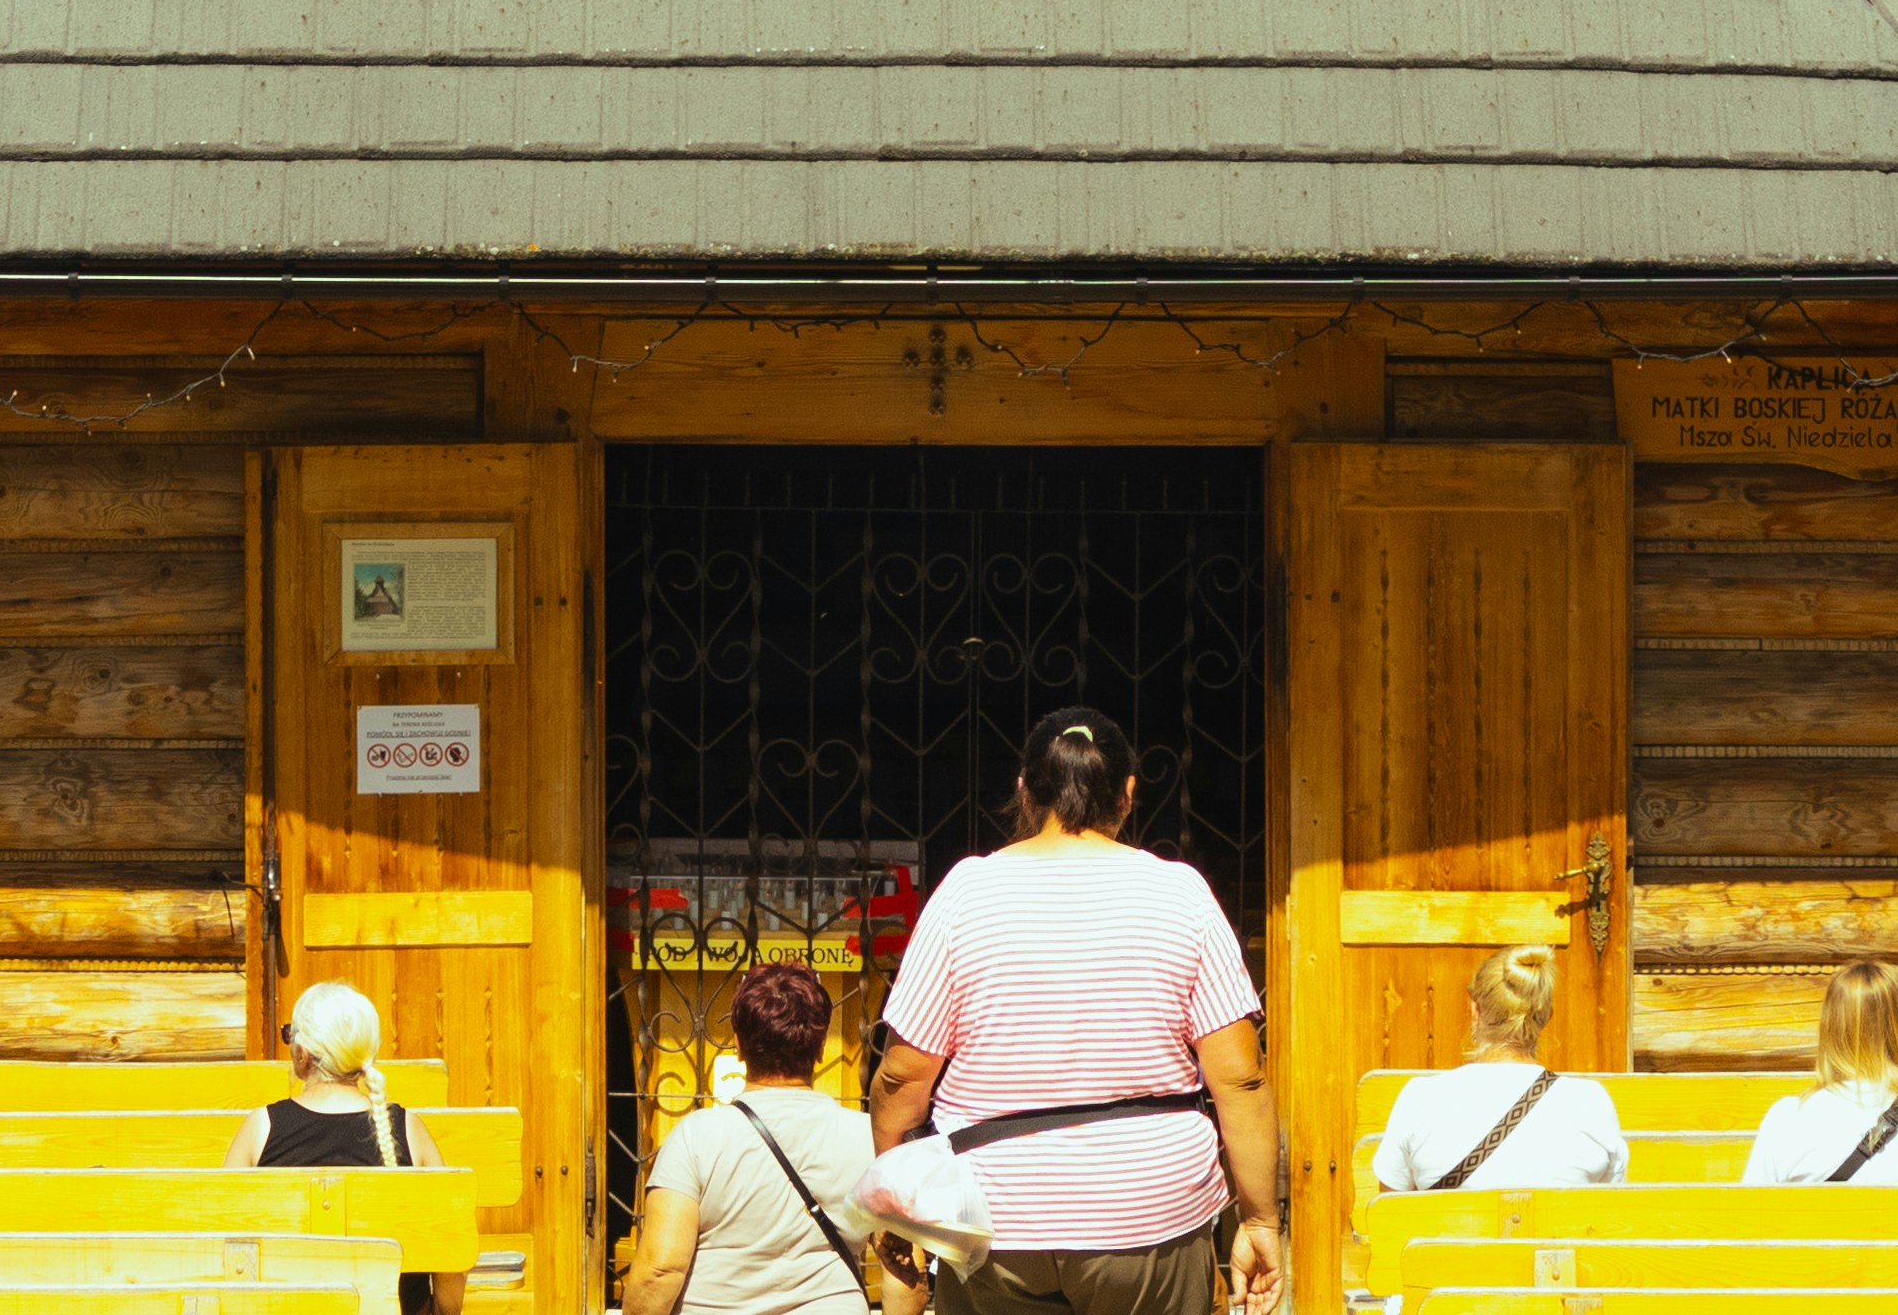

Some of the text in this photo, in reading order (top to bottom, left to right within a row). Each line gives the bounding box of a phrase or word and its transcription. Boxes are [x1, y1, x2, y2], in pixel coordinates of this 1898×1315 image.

[1652, 396, 1719, 419] MATKI
[1734, 397, 1826, 424] BOSKIEJ
[1679, 425, 1733, 447] Msza
[1741, 421, 1777, 449] Św.
[1787, 425, 1892, 448] Niedziela
